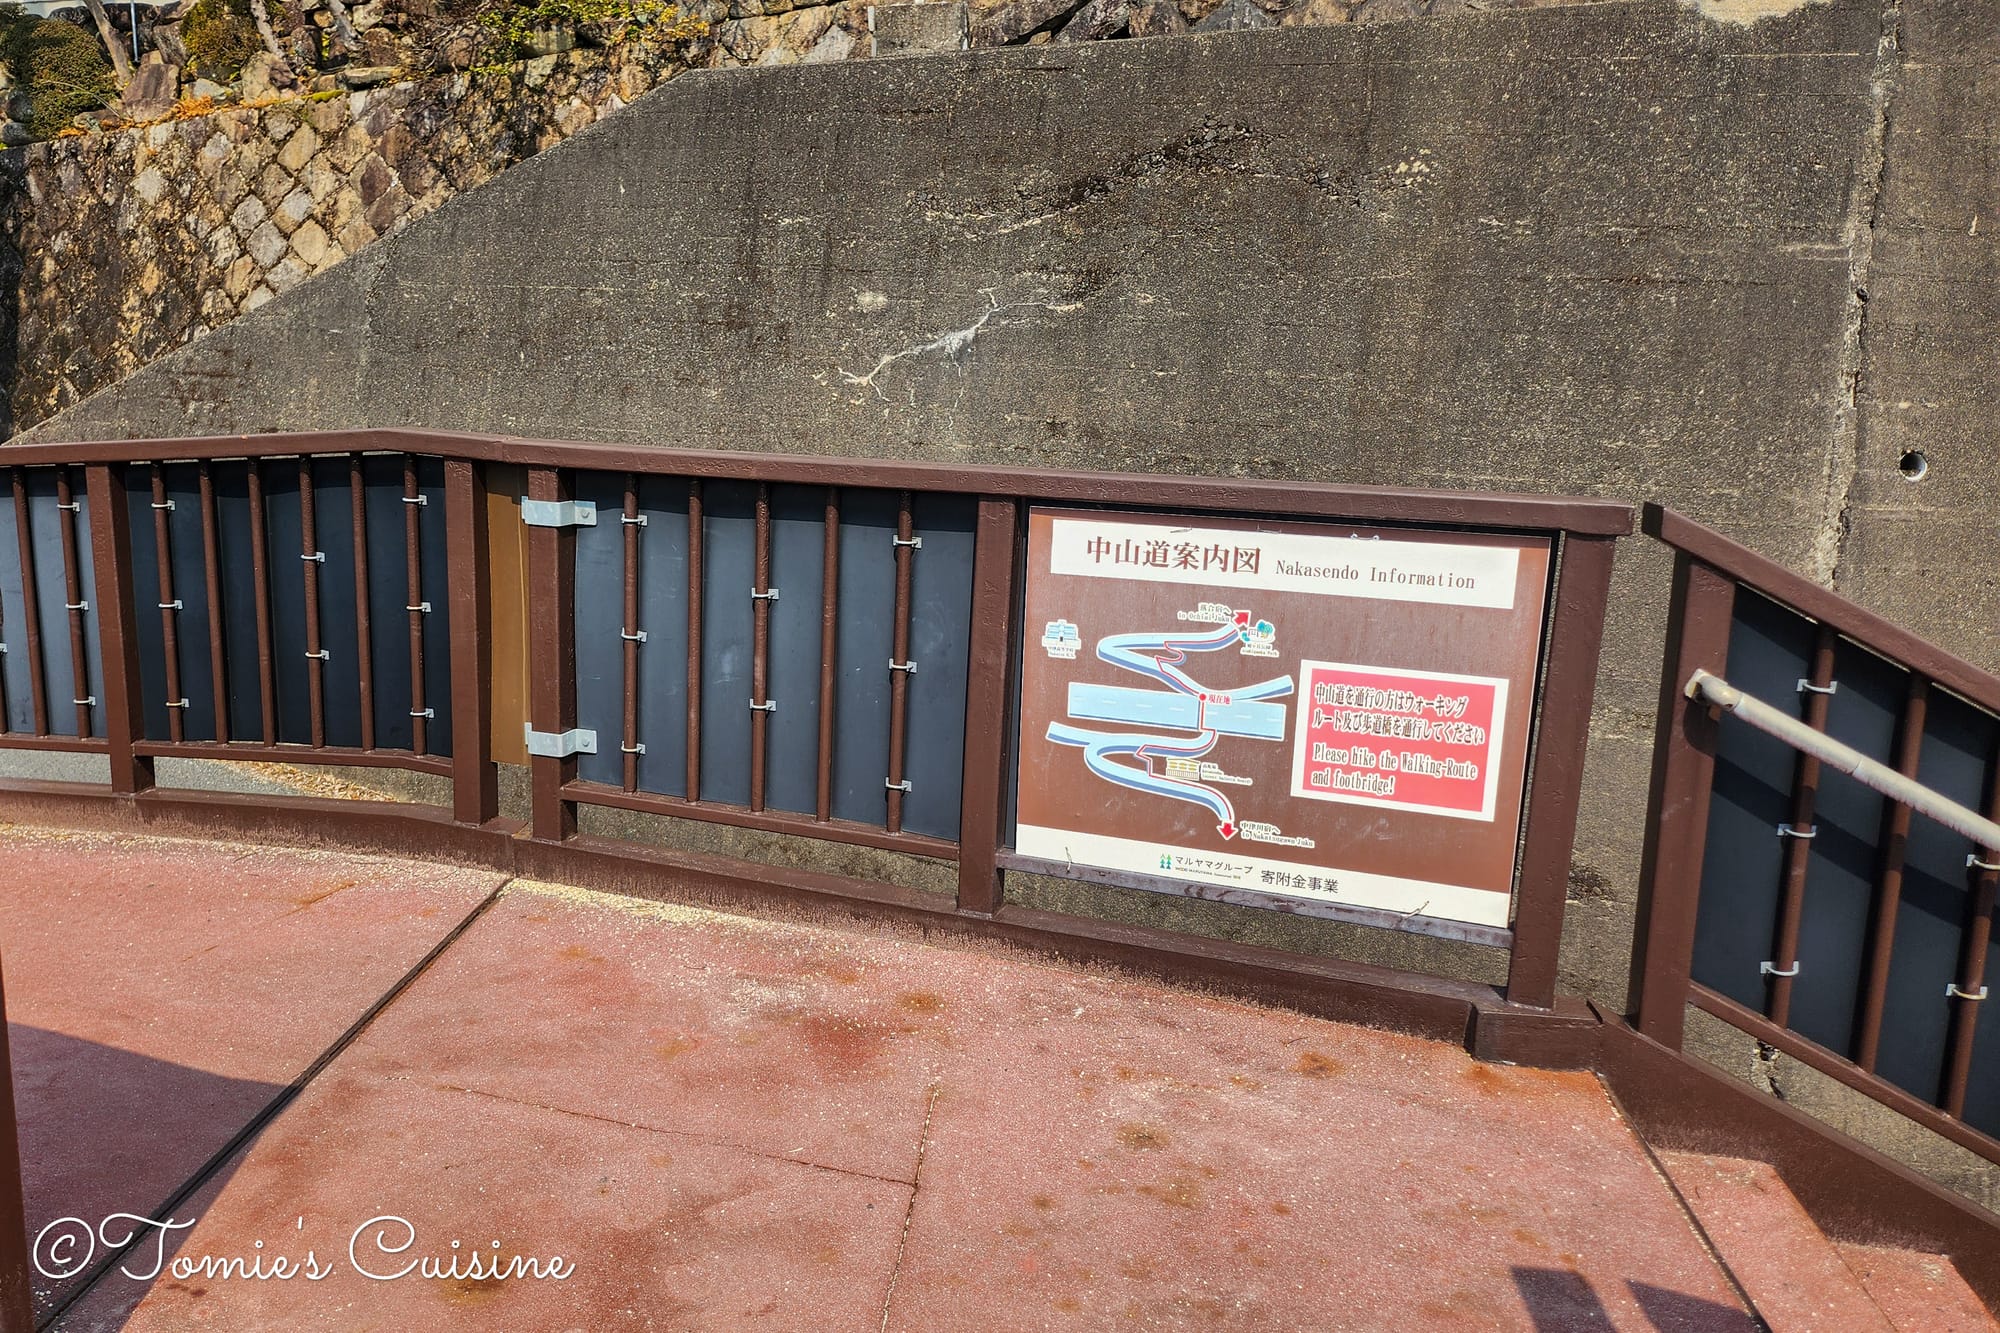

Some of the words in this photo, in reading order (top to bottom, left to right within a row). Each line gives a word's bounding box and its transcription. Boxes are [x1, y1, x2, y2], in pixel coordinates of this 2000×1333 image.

[1087, 536, 1261, 574] 中山道案内図
[1275, 559, 1359, 580] Nakasendo
[1370, 567, 1475, 589] Information
[1208, 694, 1231, 705] 現在地
[1315, 683, 1468, 717] 中山道を通行の方はウォーキング
[1312, 710, 1485, 744] ルート及び歩道橋を通行してください
[1314, 743, 1347, 763] Please
[1352, 748, 1375, 766] hike
[1380, 750, 1397, 769] the
[1402, 753, 1477, 779] Walking-Route
[1312, 770, 1329, 785] and
[1334, 771, 1395, 794] footbridge!
[1175, 855, 1253, 874] マルヤマグループ
[1260, 869, 1339, 893] 寄附金事業
